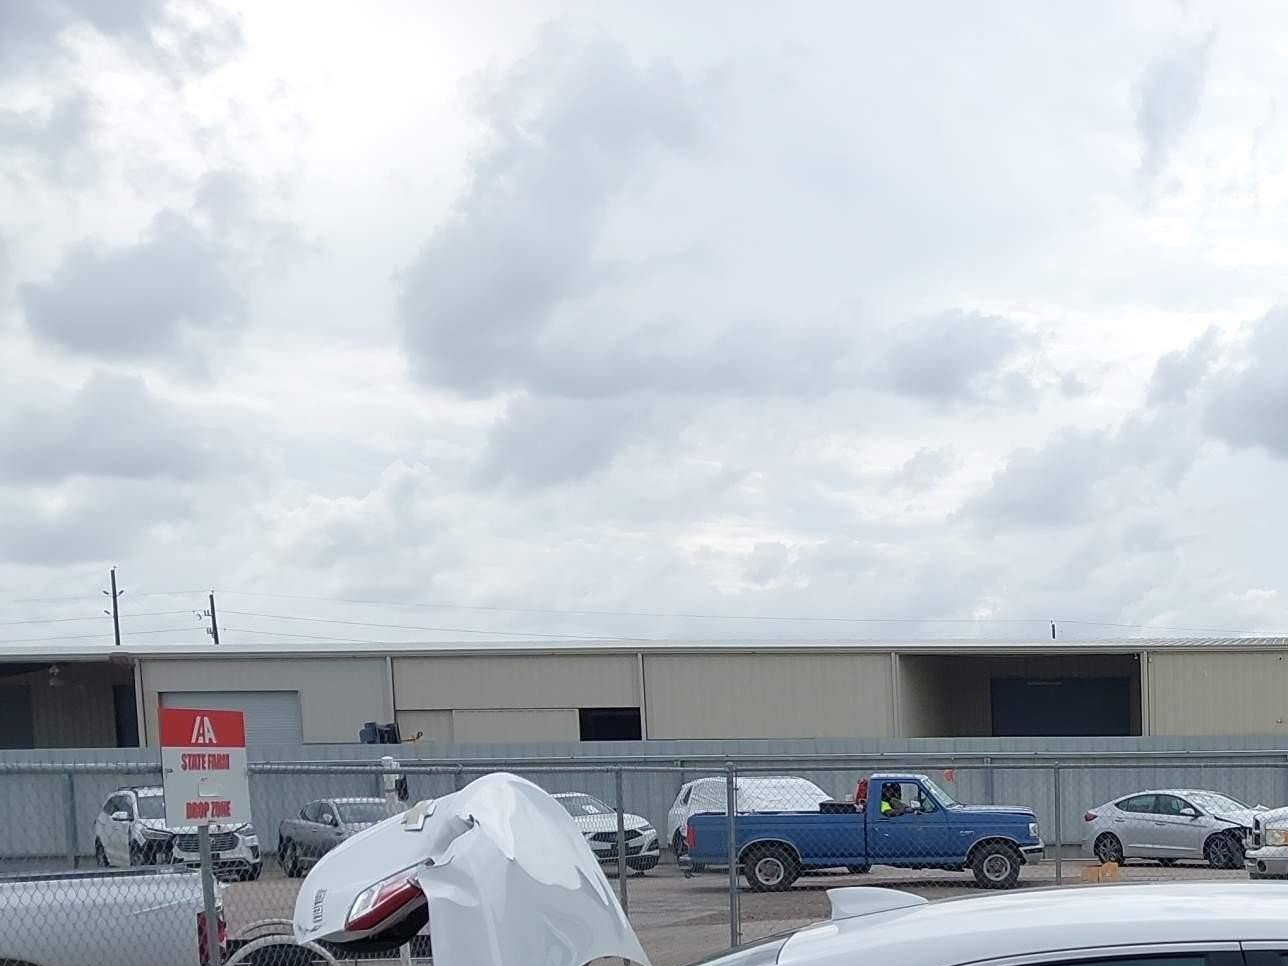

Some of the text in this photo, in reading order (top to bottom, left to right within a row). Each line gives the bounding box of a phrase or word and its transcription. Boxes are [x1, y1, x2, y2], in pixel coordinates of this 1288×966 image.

[180, 752, 230, 771] STATE FARM
[186, 800, 232, 820] DROP ZONE
